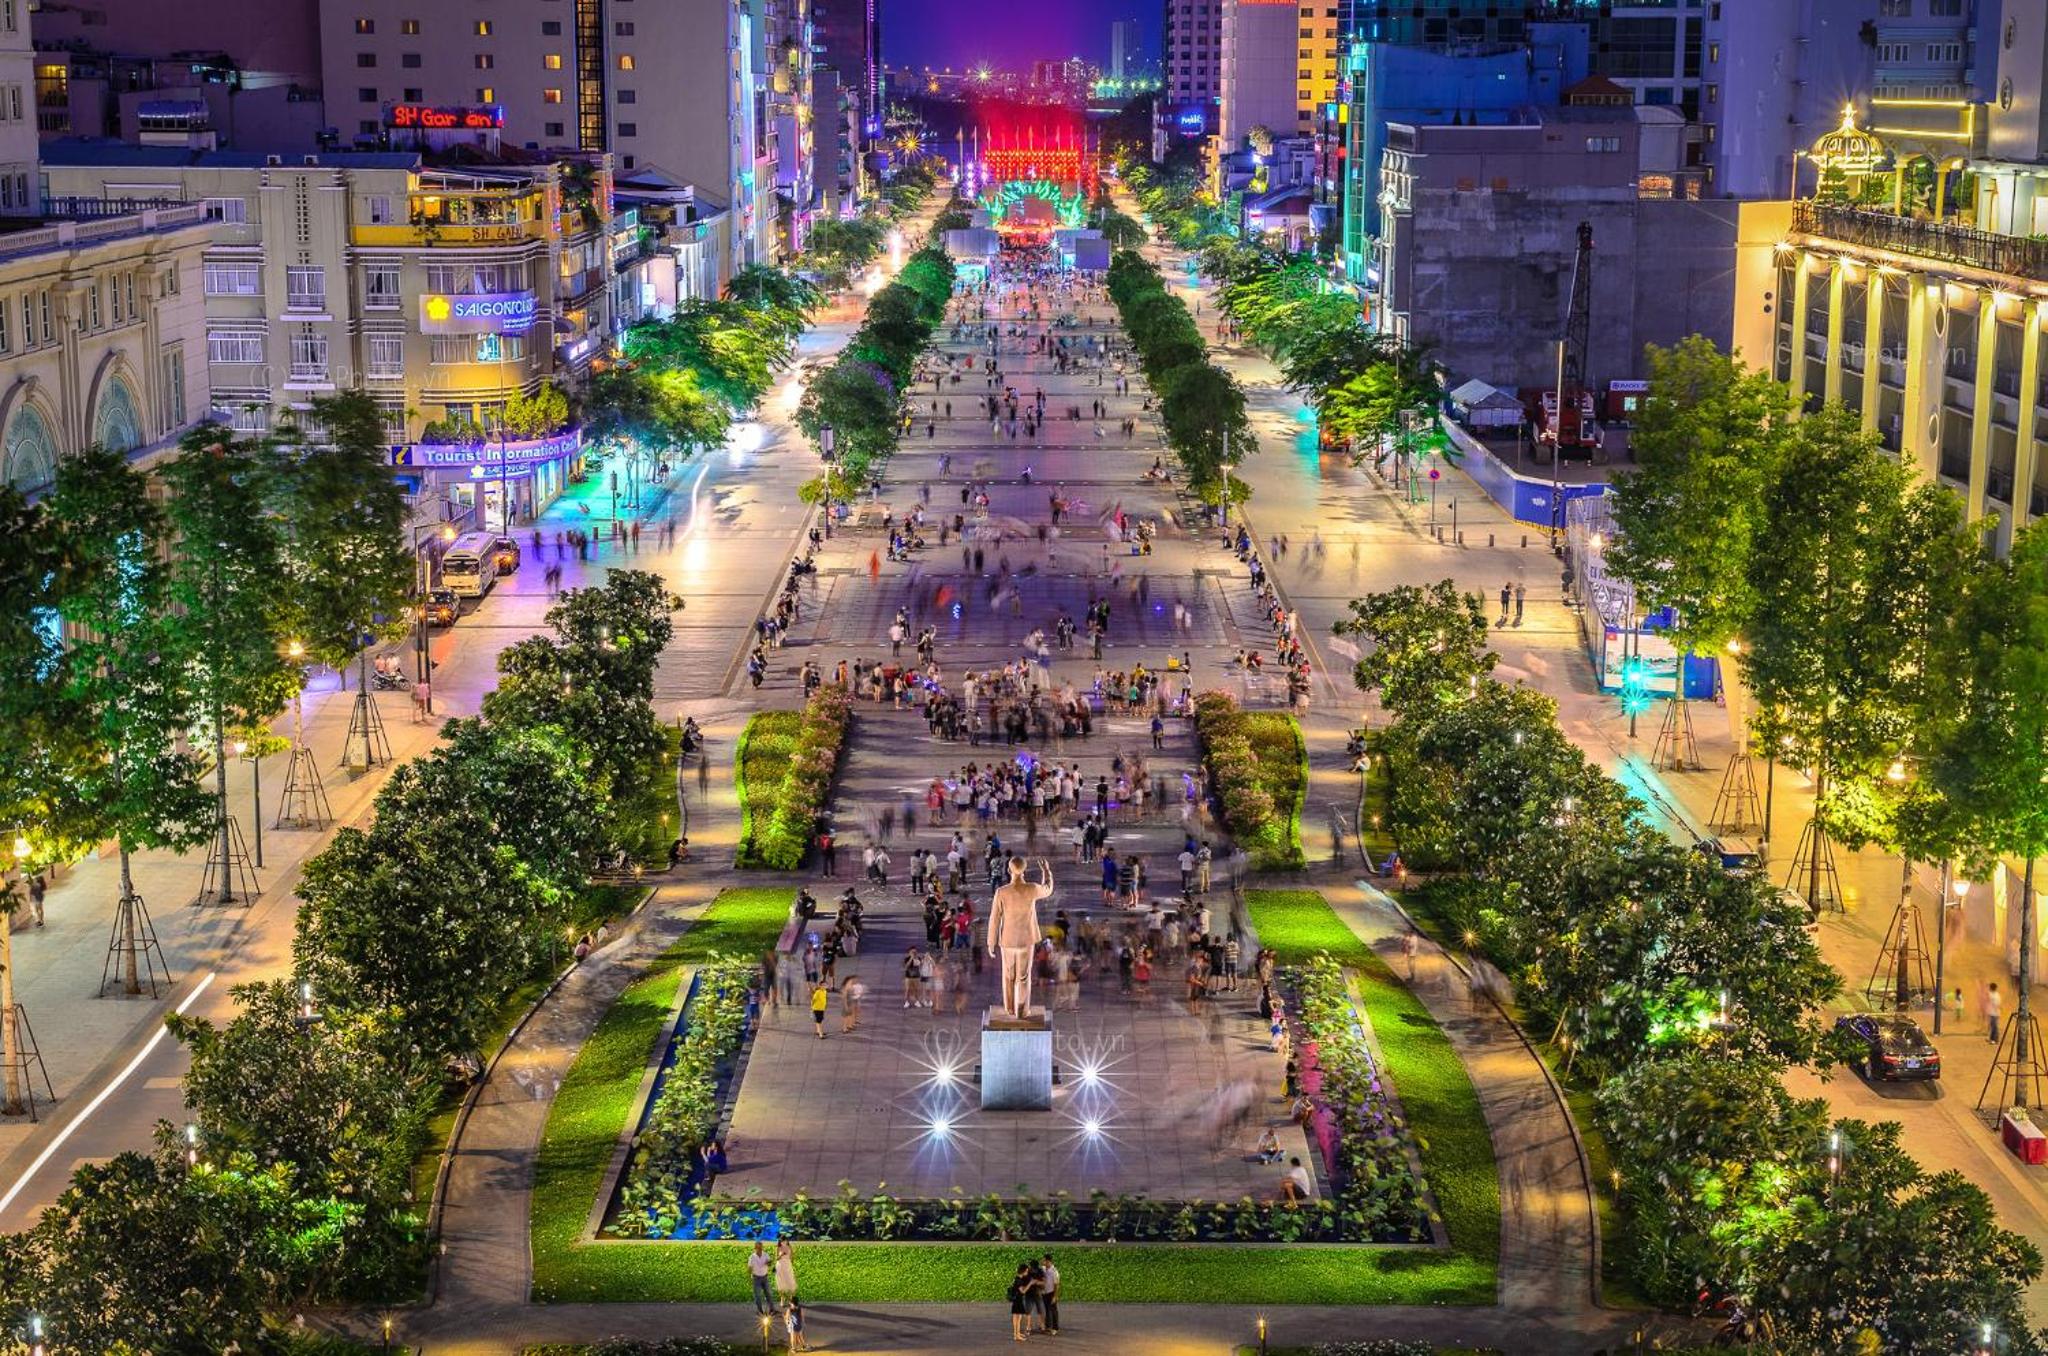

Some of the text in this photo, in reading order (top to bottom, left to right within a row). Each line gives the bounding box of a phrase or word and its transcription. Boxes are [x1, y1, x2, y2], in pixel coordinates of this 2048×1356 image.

[395, 106, 492, 127] SH Garen
[425, 448, 482, 462] Tourist
